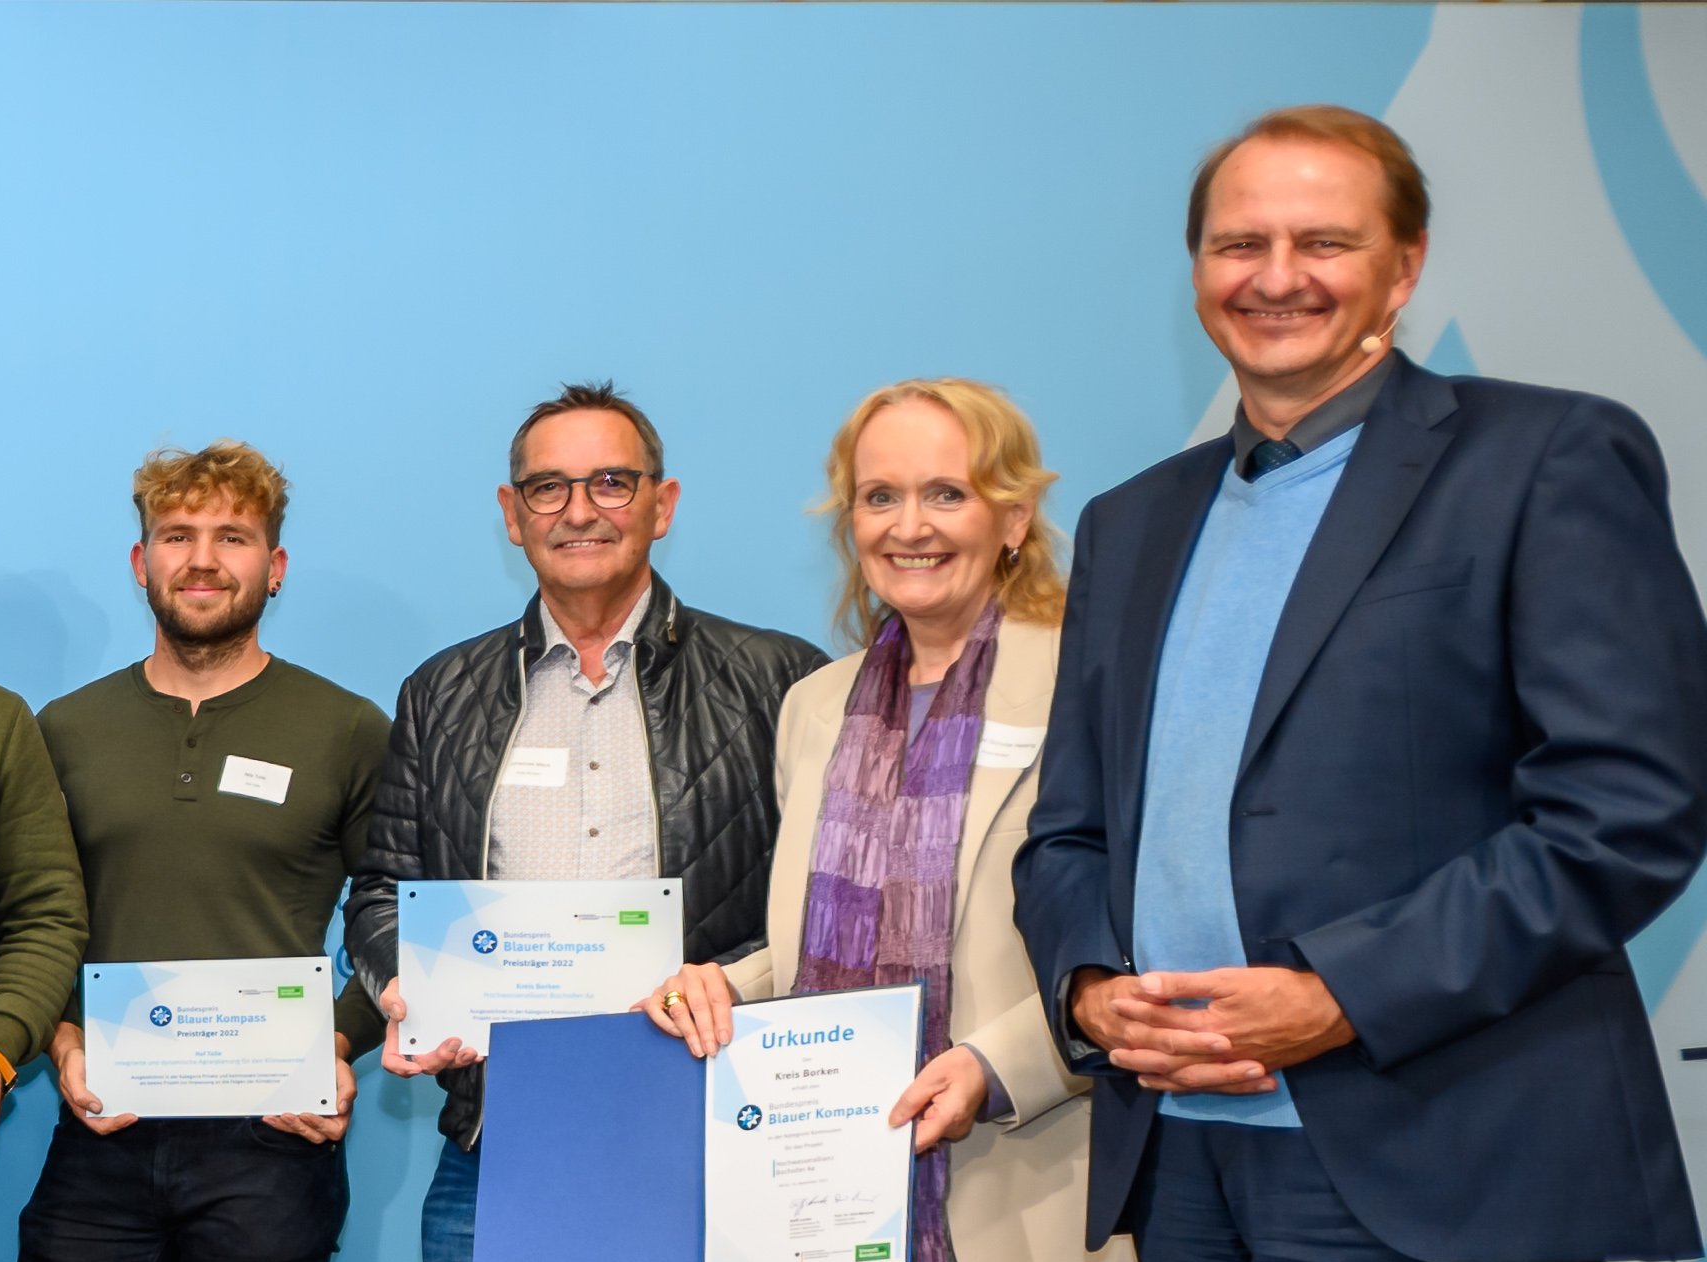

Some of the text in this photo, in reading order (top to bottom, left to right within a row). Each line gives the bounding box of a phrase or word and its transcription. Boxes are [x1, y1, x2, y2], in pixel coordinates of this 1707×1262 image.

[503, 940, 605, 954] Blauer Kompass
[503, 959, 574, 968] Preisträger 2022
[177, 1014, 267, 1025] Blauer Kompass
[177, 1029, 240, 1038] Preisträger 2022
[762, 1024, 855, 1049] Urkunde
[775, 1067, 839, 1081] Kreis Borken
[769, 1105, 880, 1125] Blauer Kompass
